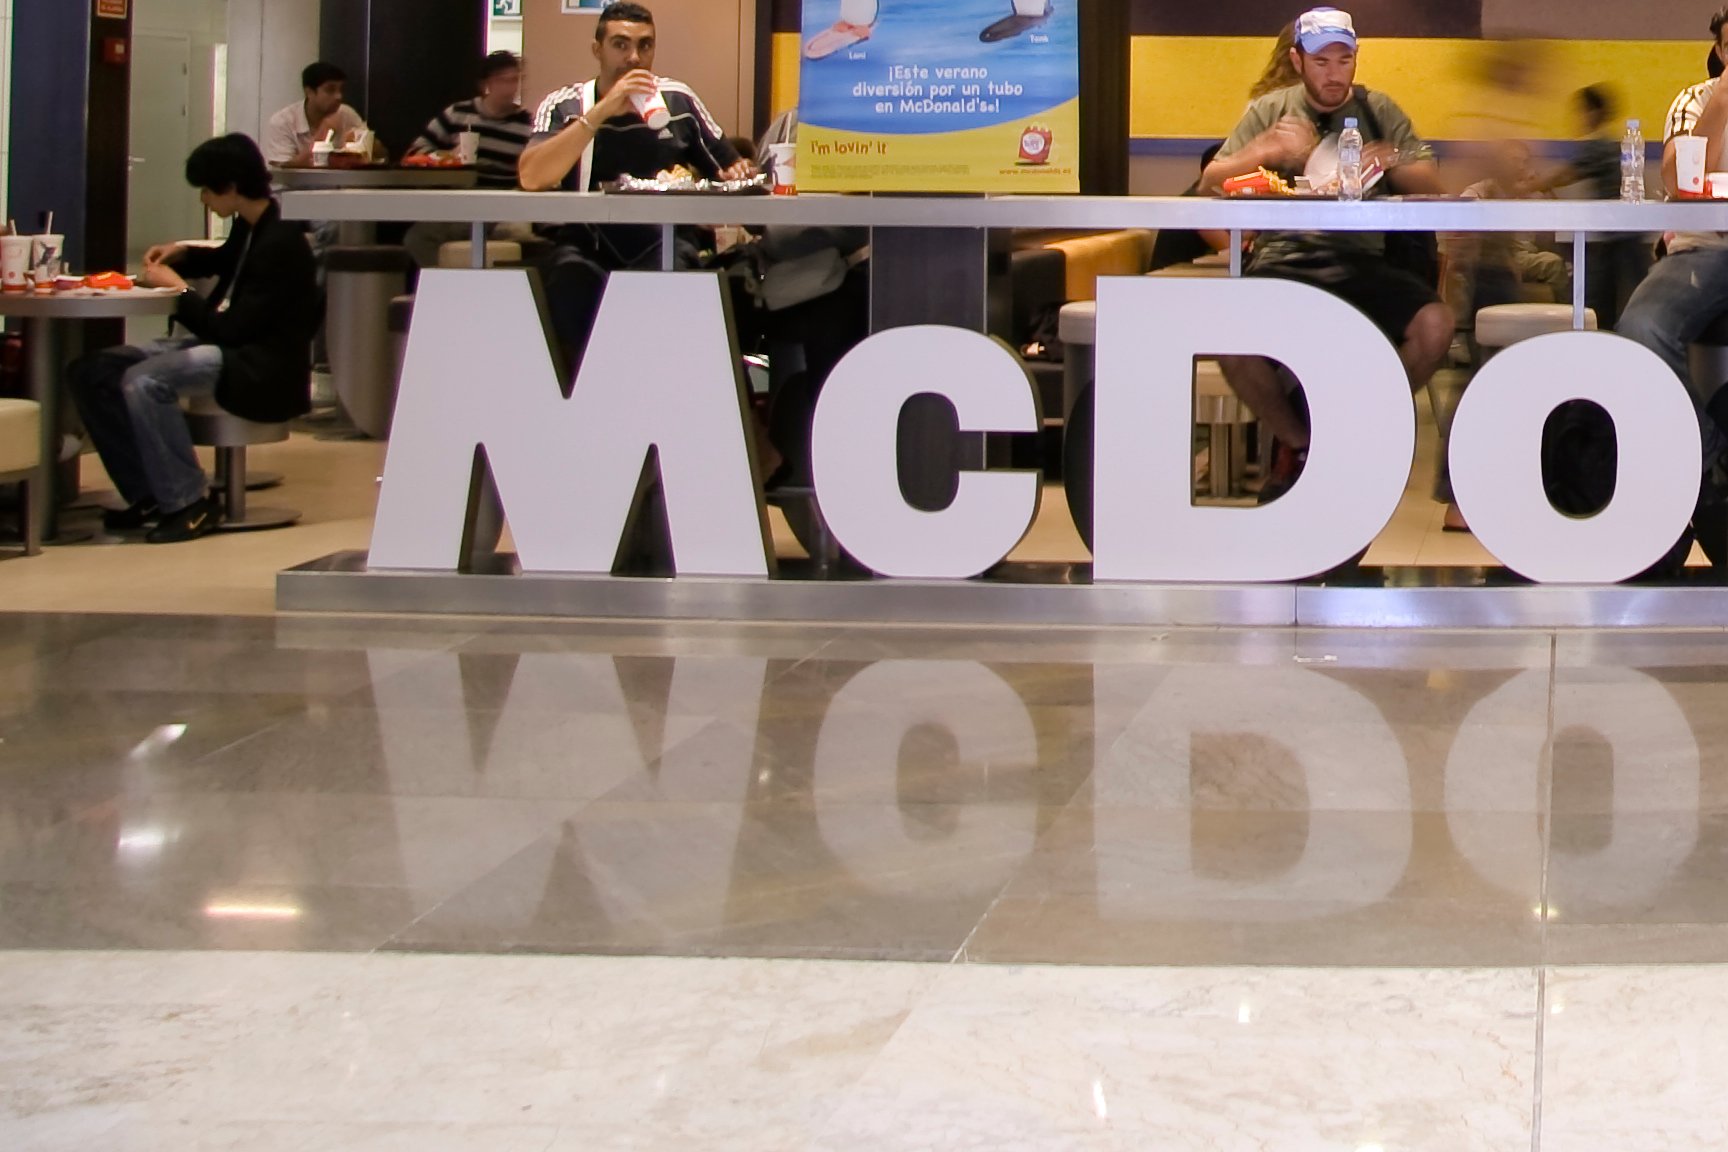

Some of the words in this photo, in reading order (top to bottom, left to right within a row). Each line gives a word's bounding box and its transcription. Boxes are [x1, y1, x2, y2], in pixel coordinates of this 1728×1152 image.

[889, 64, 929, 82] ¡Este
[935, 66, 988, 80] verano
[852, 80, 923, 97] diversión
[929, 83, 956, 100] por
[961, 84, 980, 96] un
[987, 80, 1023, 96] tubo
[875, 101, 893, 113] en
